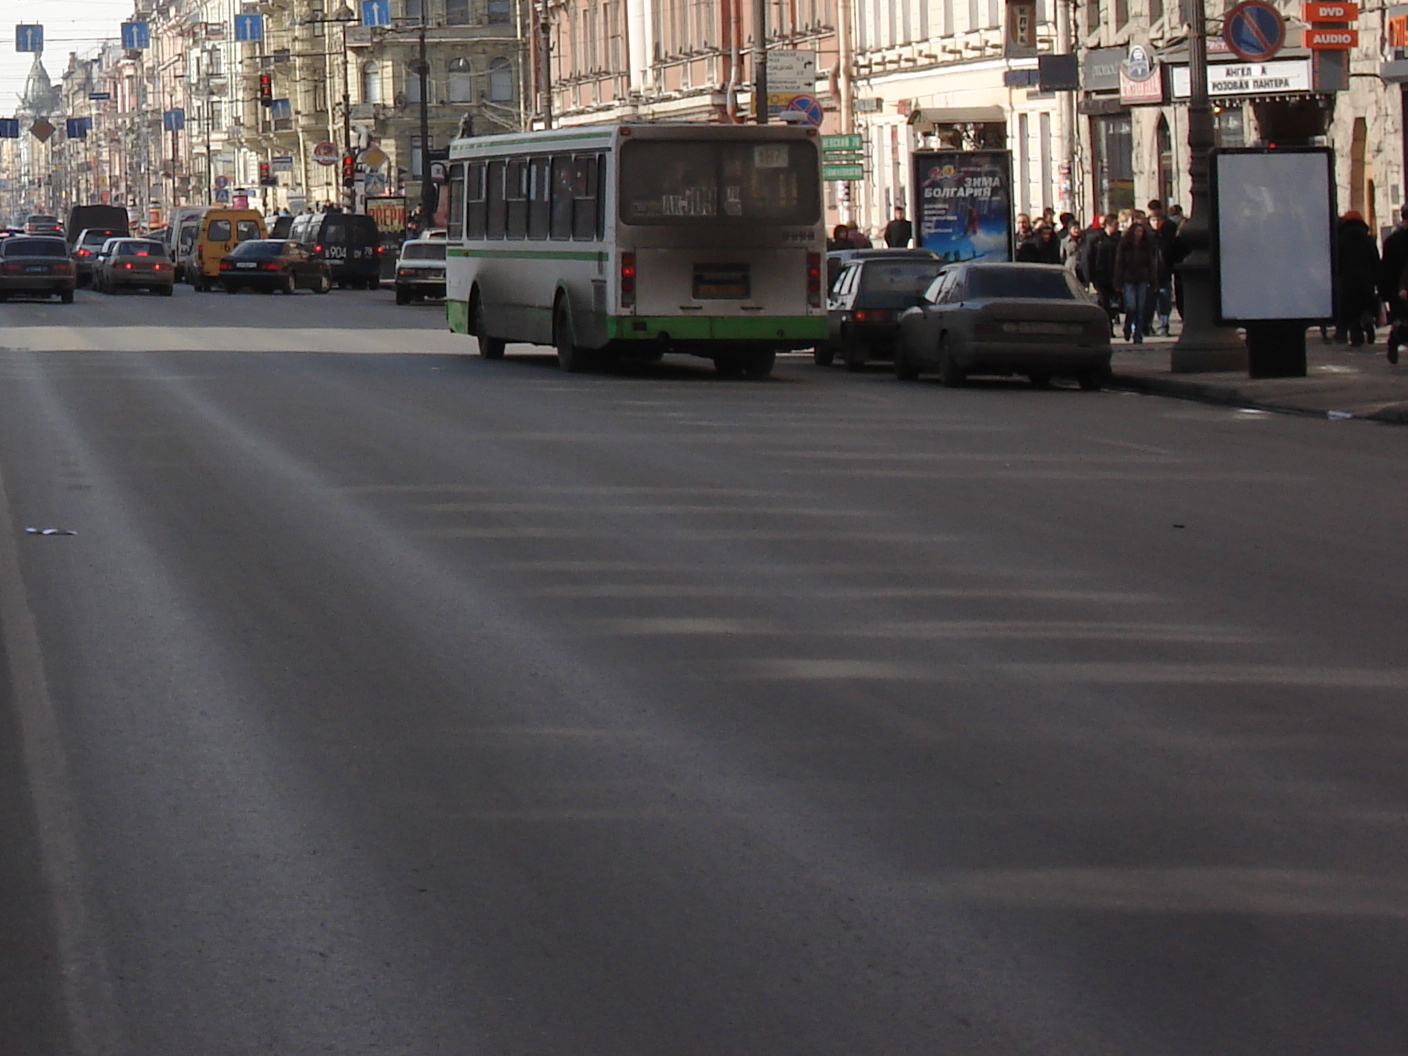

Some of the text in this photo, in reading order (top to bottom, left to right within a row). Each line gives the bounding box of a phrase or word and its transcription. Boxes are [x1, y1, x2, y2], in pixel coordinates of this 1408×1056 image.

[1319, 7, 1344, 17] DVD
[1313, 33, 1352, 44] AUDIO
[1225, 66, 1252, 77] АНГЕЛ
[1212, 78, 1290, 91] РОЗОВАЯ ПАНТЕРА
[963, 177, 1001, 188] ЗИМА
[923, 187, 992, 198] БОЛГАРИЯ
[330, 246, 347, 259] 904
